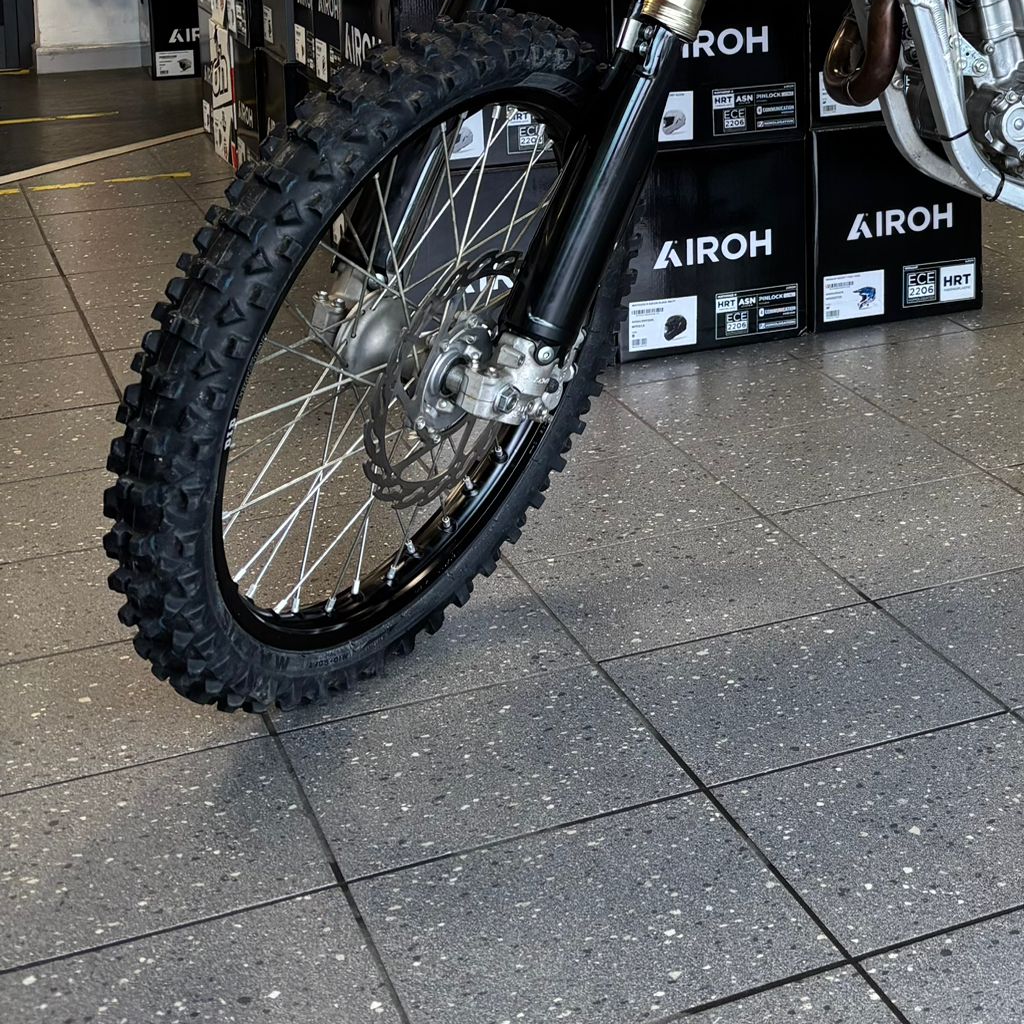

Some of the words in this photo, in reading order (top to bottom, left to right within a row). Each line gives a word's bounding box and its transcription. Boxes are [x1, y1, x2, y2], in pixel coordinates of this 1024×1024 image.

[169, 27, 200, 43] AIR
[682, 26, 769, 59] IROH
[736, 94, 753, 102] ASN
[724, 109, 745, 119] ECE
[725, 119, 745, 128] 2206
[847, 202, 953, 241] AIROH
[653, 228, 772, 270] AIROH
[909, 272, 935, 286] ECE
[943, 273, 971, 287] HRT
[909, 285, 934, 297] 2206
[717, 300, 736, 309] HRT
[738, 297, 756, 306] ASN
[726, 312, 748, 323] ECE
[726, 321, 748, 330] 2206
